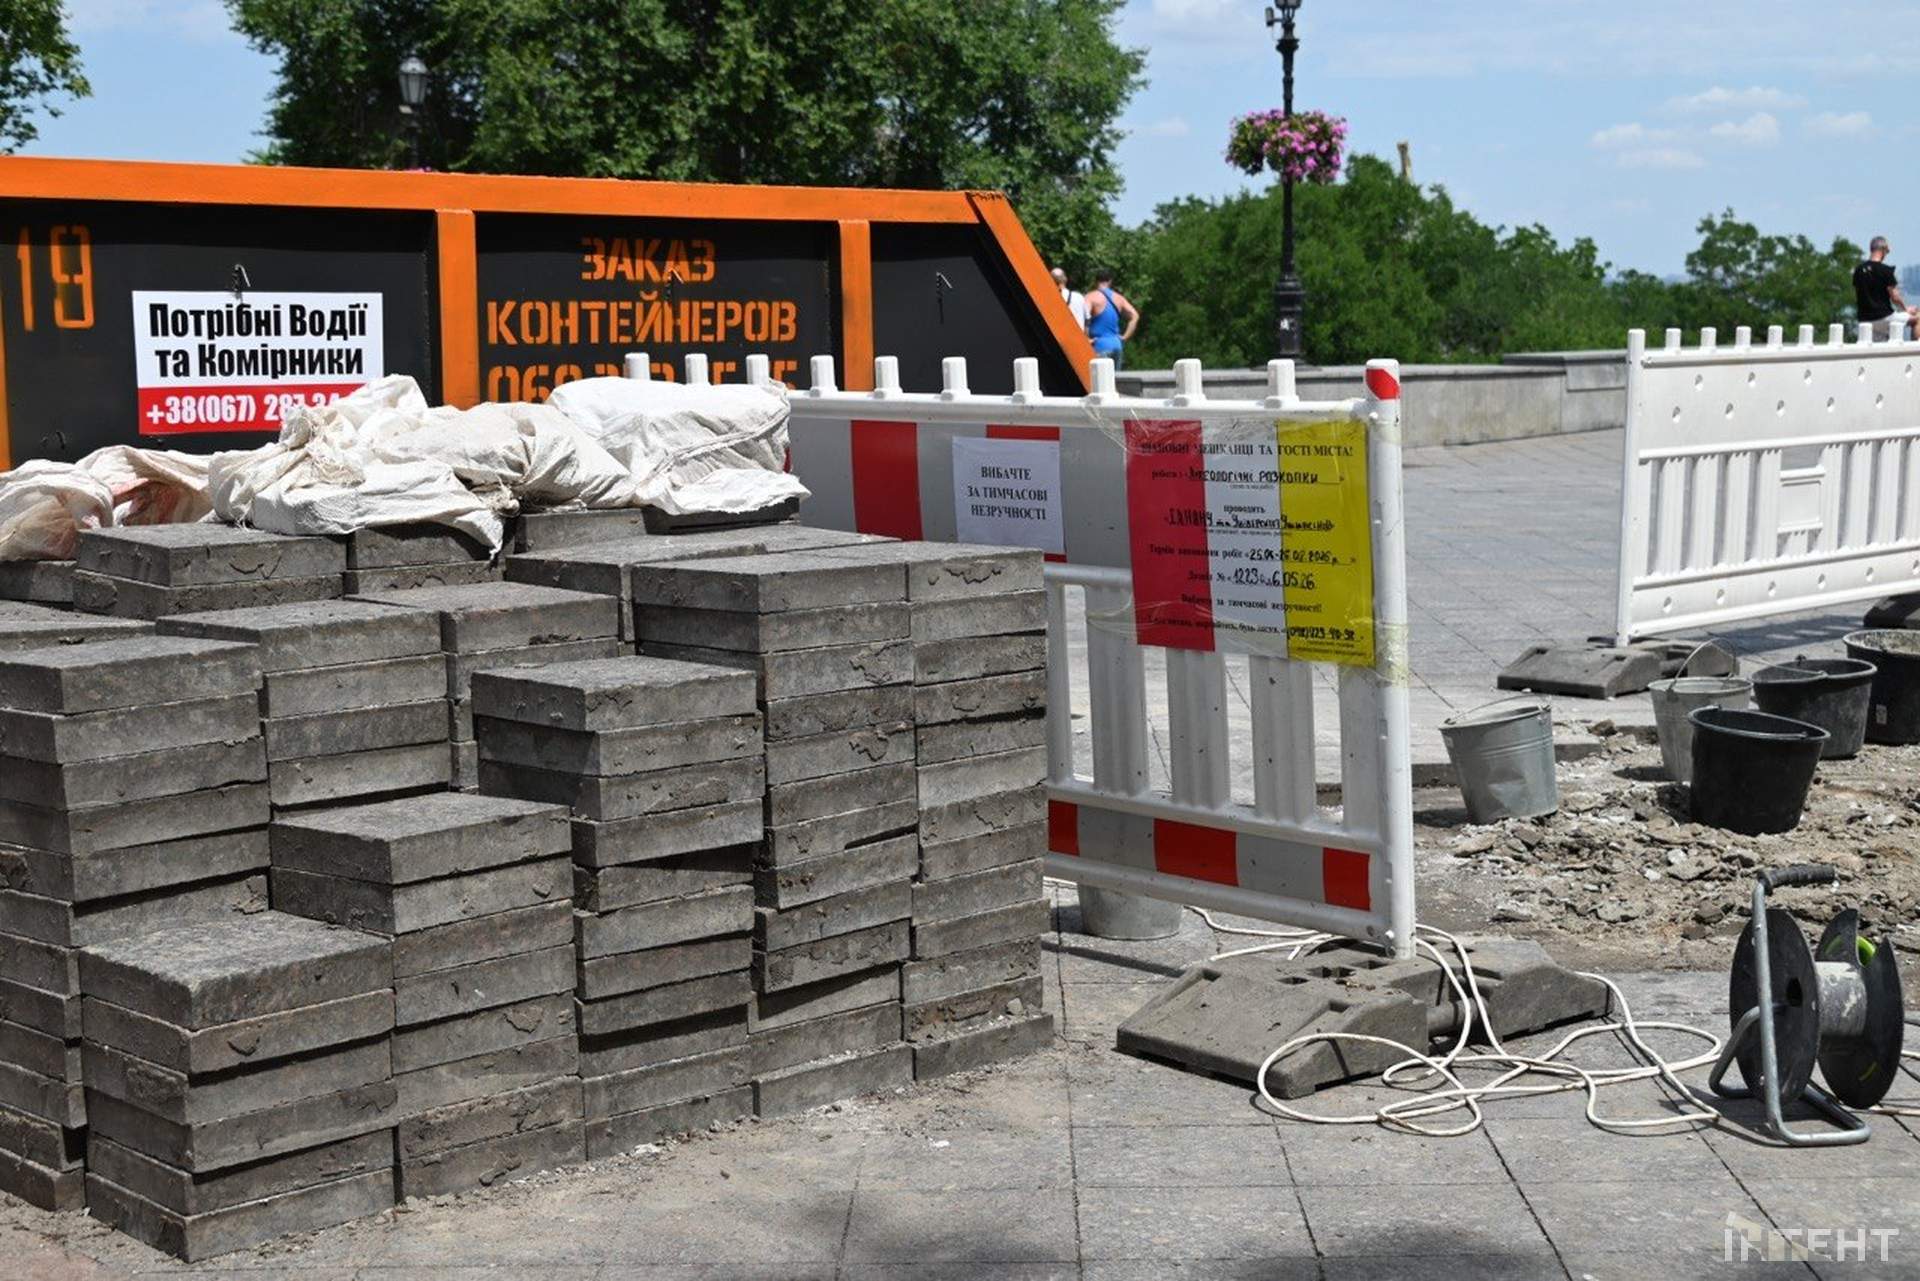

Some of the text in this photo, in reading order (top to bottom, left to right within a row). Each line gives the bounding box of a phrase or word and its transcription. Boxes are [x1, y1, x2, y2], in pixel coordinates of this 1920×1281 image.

[580, 238, 716, 283] ЗАКАЗ
[149, 303, 368, 340] Потрібні Водії
[487, 290, 798, 345] КОНТЕЙНЕРОВ
[154, 344, 363, 380] та Комірники
[146, 394, 257, 425] +38(067)
[1258, 445, 1273, 455] ТА
[1278, 445, 1311, 456] ГОСТІ
[980, 465, 1032, 480] ВИБАЧТЕ
[967, 485, 1048, 501] ЗА ТИМЧАСОВІ
[970, 504, 1046, 520] НЕЗРУЧНОСТІ
